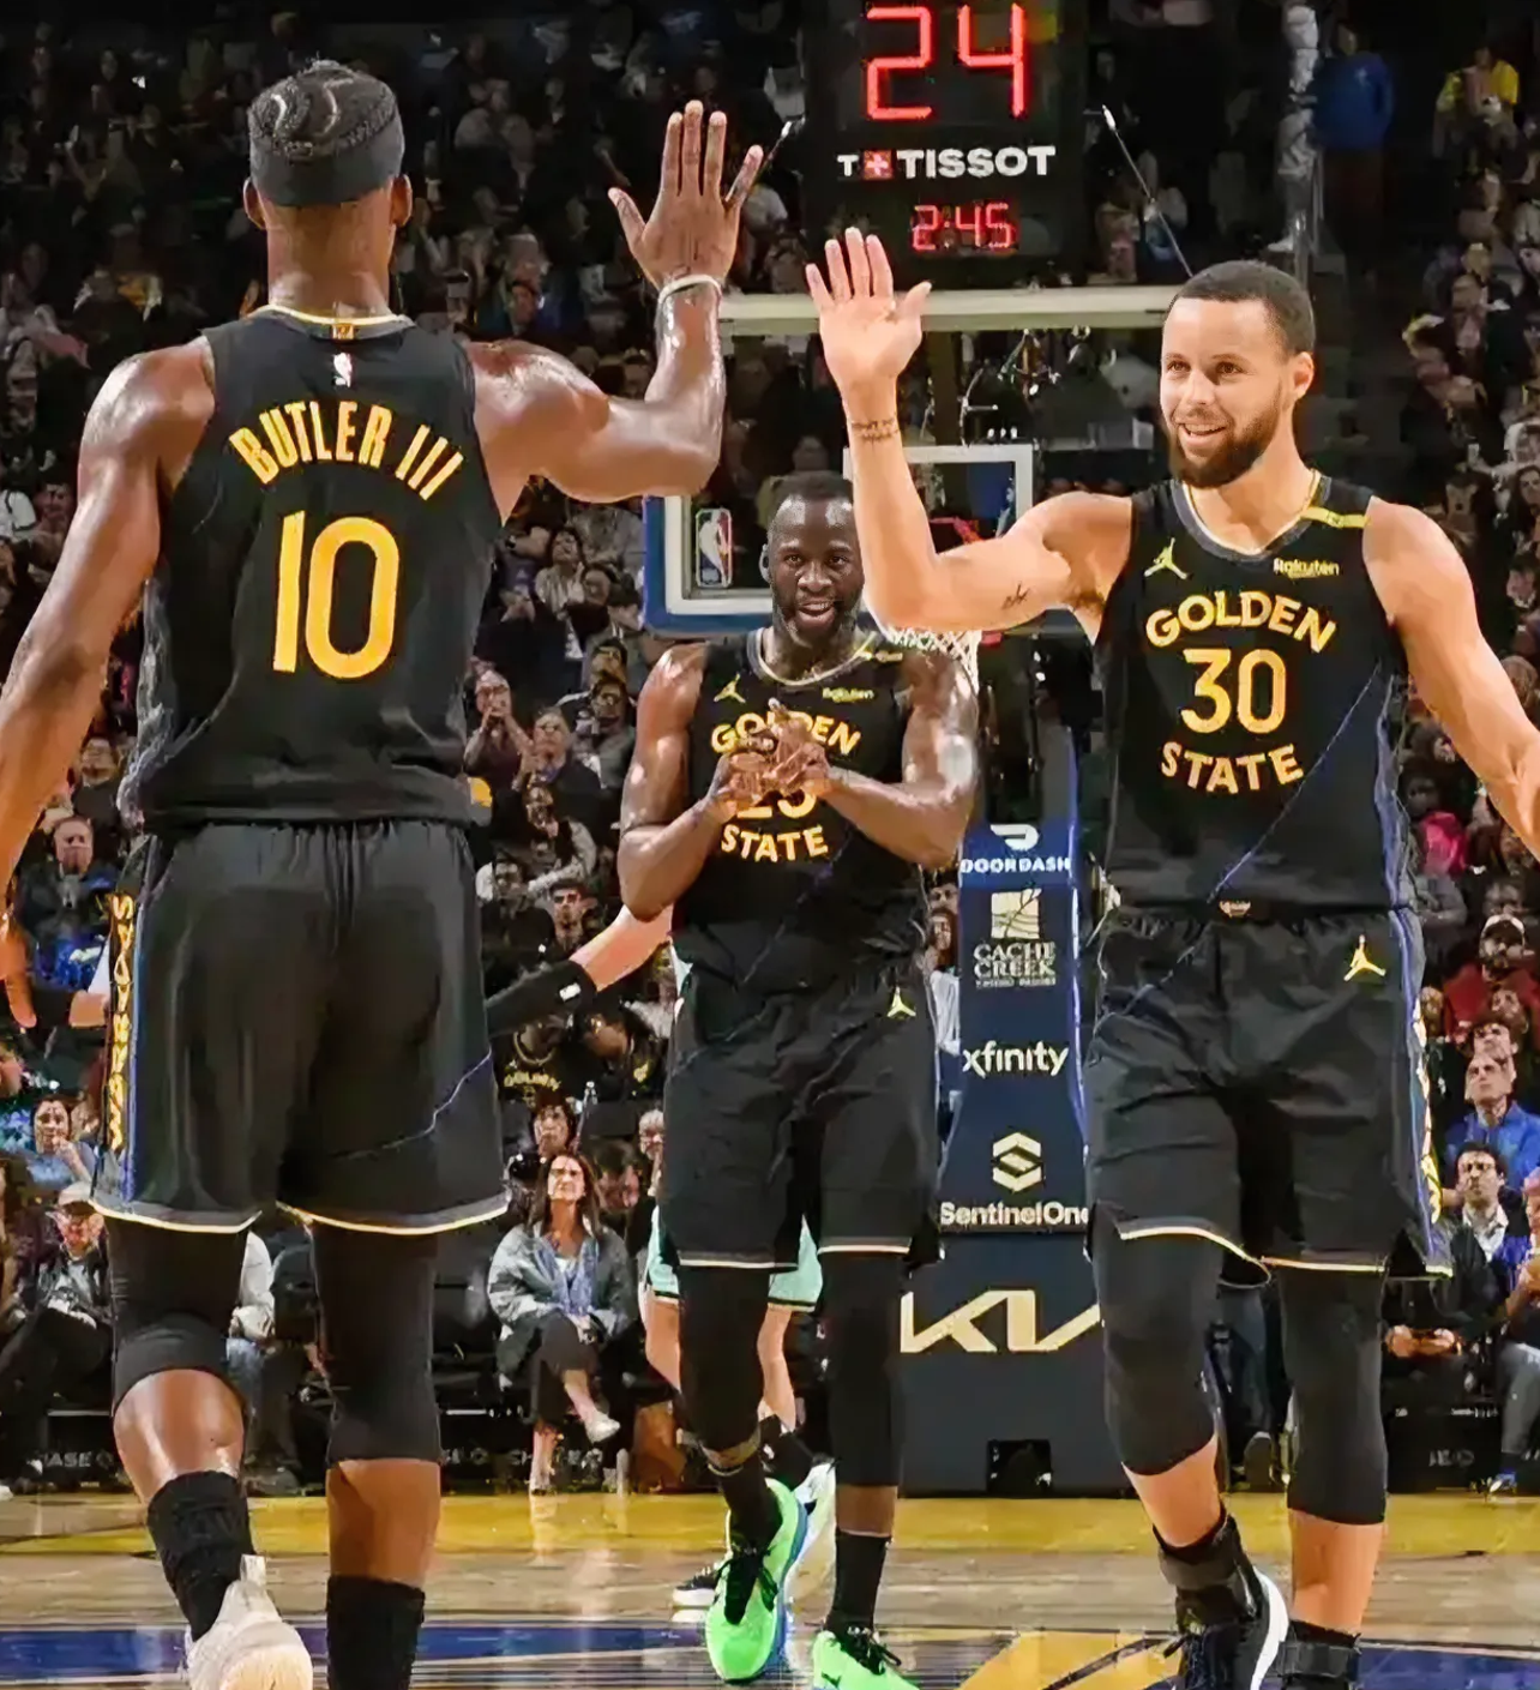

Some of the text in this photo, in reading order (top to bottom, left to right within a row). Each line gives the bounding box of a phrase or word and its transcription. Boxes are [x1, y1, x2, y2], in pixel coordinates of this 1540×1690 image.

[866, 3, 1024, 120] 24
[896, 146, 1056, 179] TISSOT
[912, 203, 1011, 250] 2:45
[229, 401, 464, 500] BUTLER III
[1273, 558, 1340, 577] Rakuten
[273, 511, 399, 679] 10
[1146, 590, 1337, 653] GOLDEN
[1180, 649, 1286, 734] 30
[1161, 742, 1304, 794] STATE
[721, 824, 829, 863] STATE
[960, 856, 1071, 874] DOORDASH
[973, 941, 1056, 962] CACHE
[962, 1039, 1069, 1079] xfinity
[44, 1452, 92, 1468] ASE
